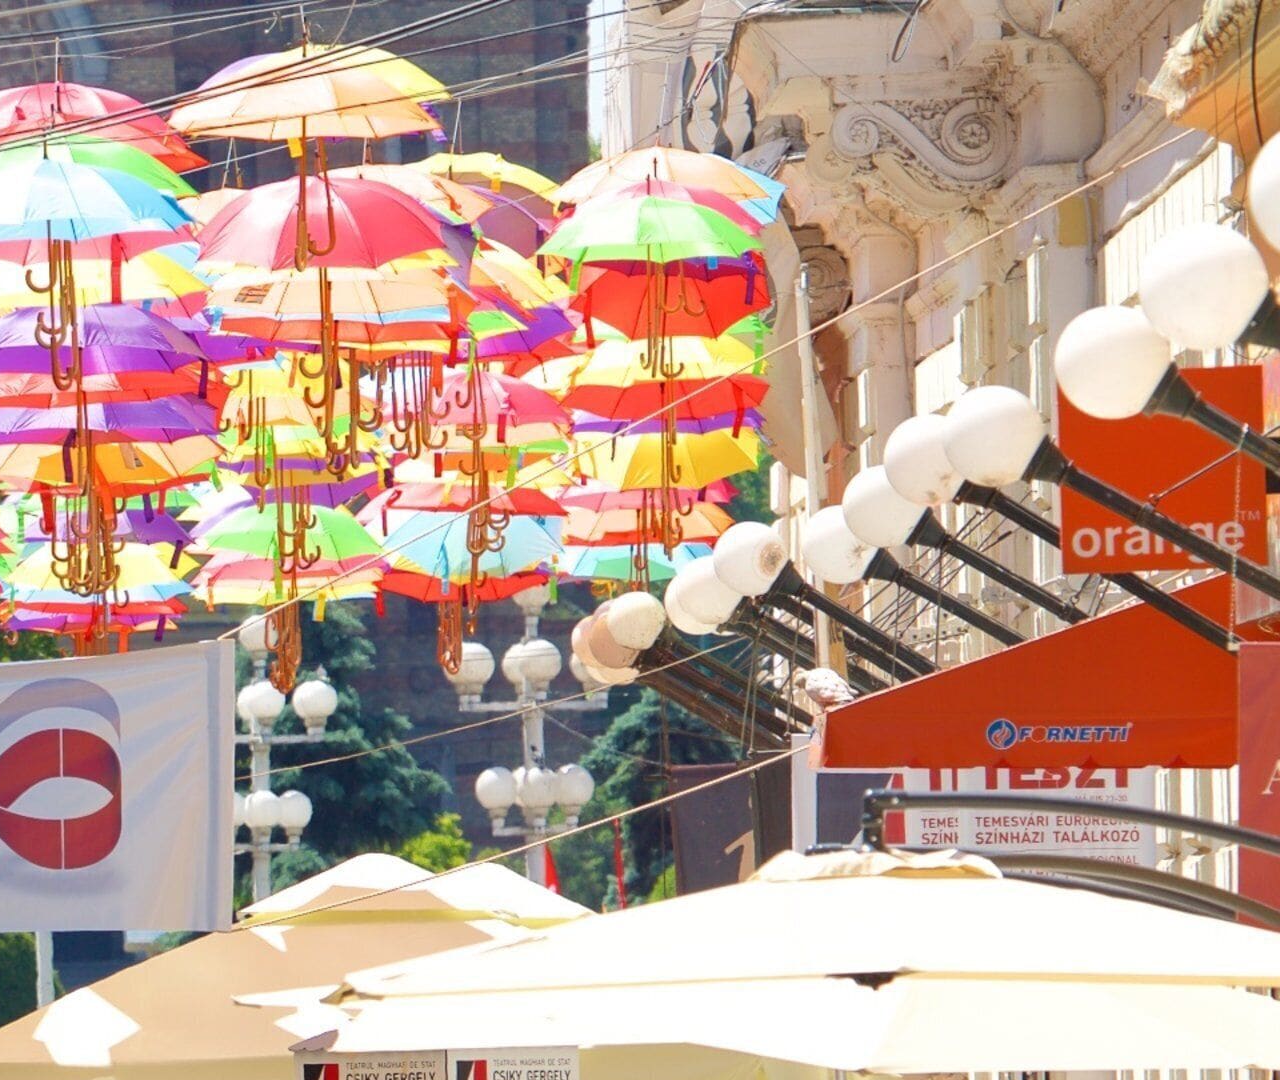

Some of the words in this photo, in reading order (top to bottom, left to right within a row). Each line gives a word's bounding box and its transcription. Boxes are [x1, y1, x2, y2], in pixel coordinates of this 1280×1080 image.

[1017, 725, 1129, 744] FORNETTI
[975, 812, 1049, 827] TEMESVÁRI
[975, 827, 1045, 844] SZÍNHÁZI
[1052, 826, 1141, 843] TALÁLKOZÓ
